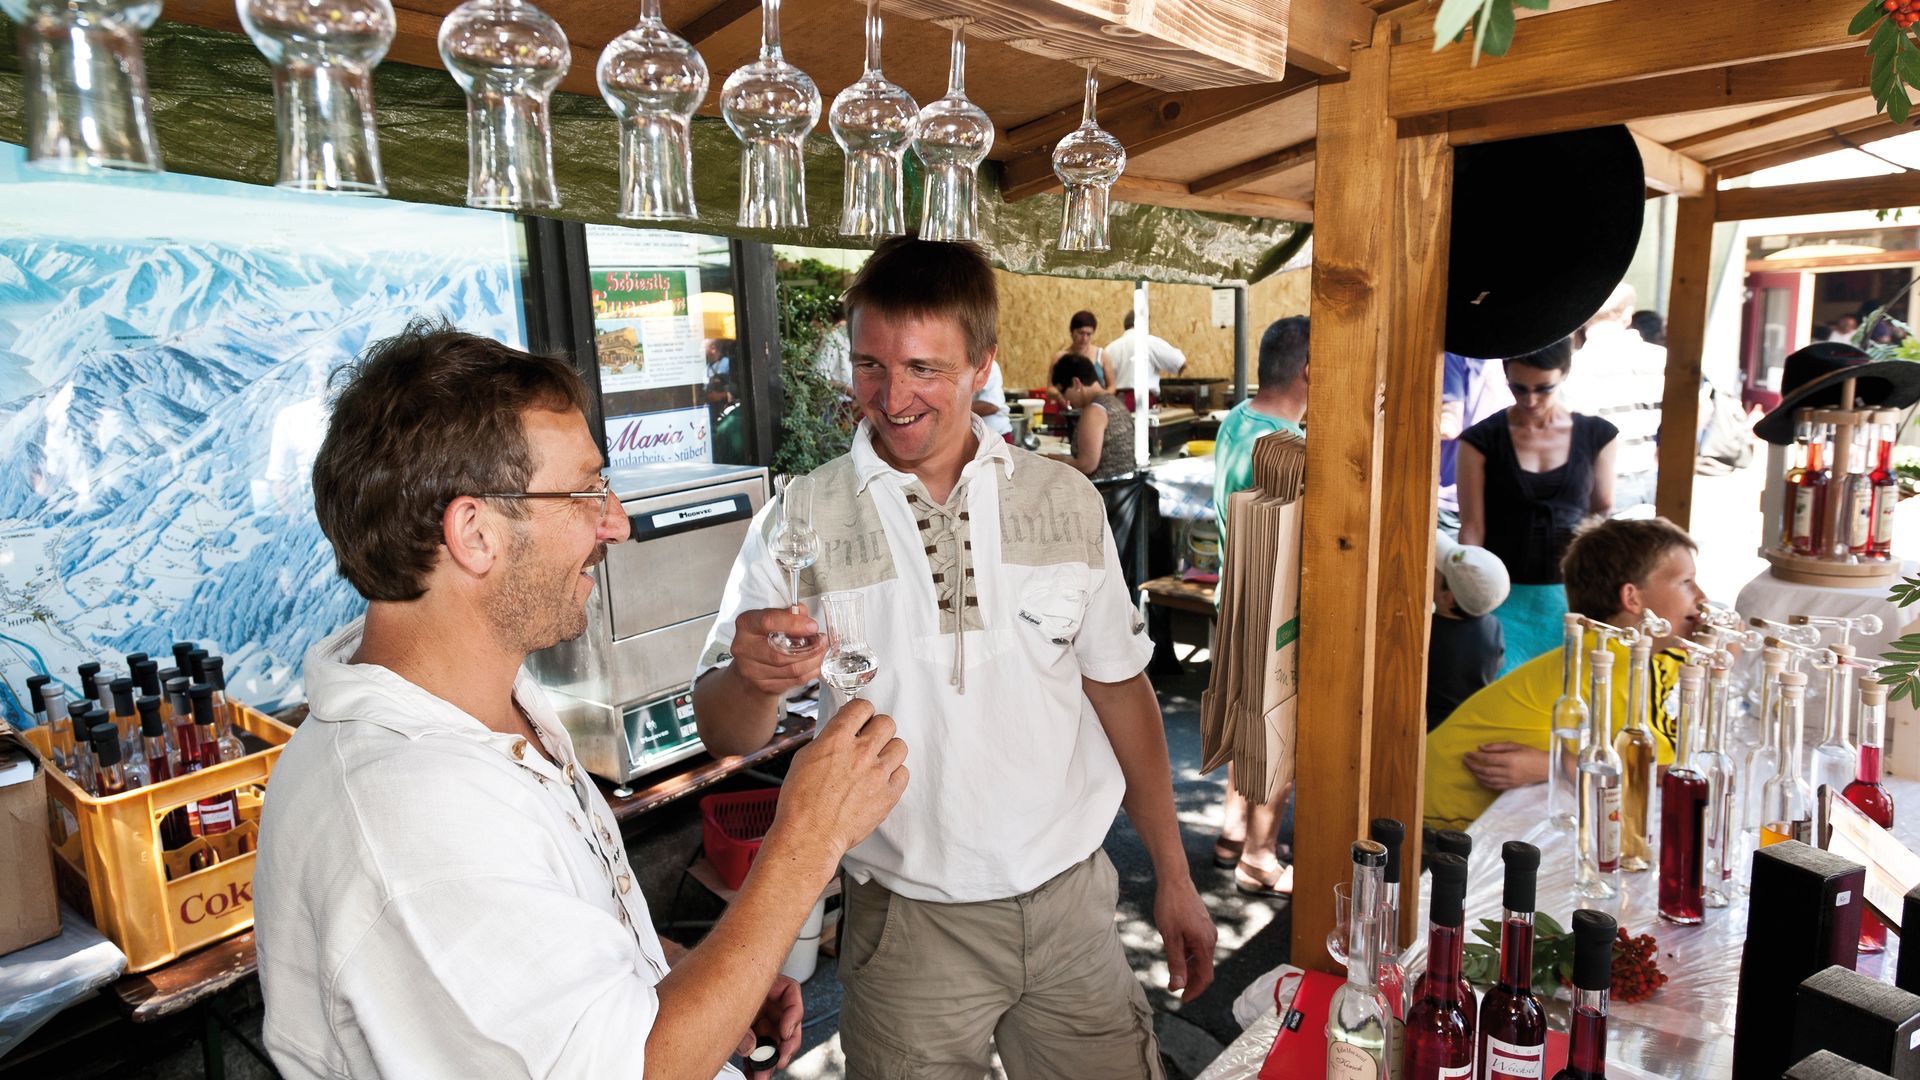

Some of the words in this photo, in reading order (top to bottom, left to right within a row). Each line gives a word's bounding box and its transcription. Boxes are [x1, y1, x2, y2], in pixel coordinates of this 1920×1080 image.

[609, 451, 665, 468] andarbeits
[674, 441, 707, 462] Stüberl
[181, 882, 253, 924] Cok
